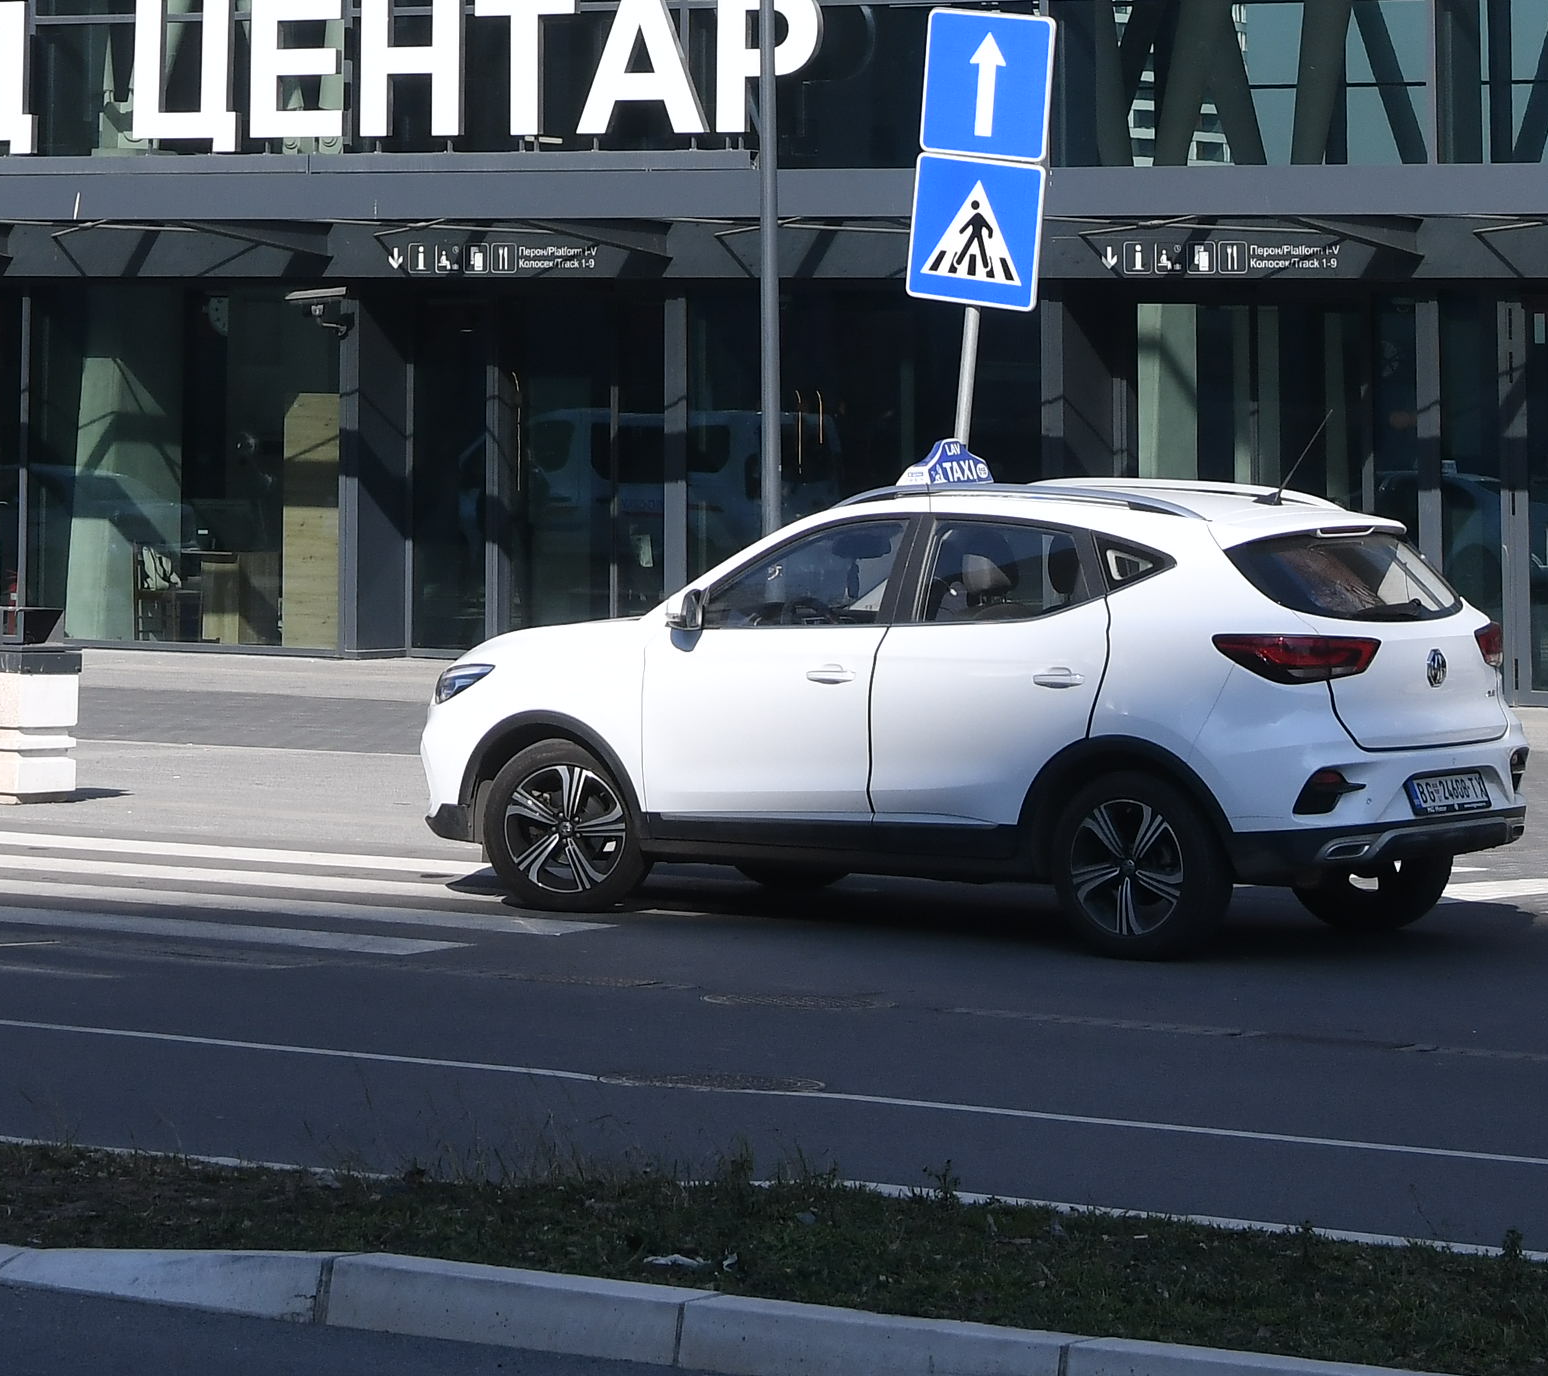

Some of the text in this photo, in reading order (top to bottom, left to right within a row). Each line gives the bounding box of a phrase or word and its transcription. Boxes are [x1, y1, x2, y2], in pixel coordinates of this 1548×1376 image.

[518, 259, 595, 268] Колосек/Track 1-9
[1250, 258, 1337, 268] Колосек/Track 1-9
[945, 443, 960, 456] LAV
[942, 459, 977, 482] TAXI
[1417, 781, 1436, 803] BG
